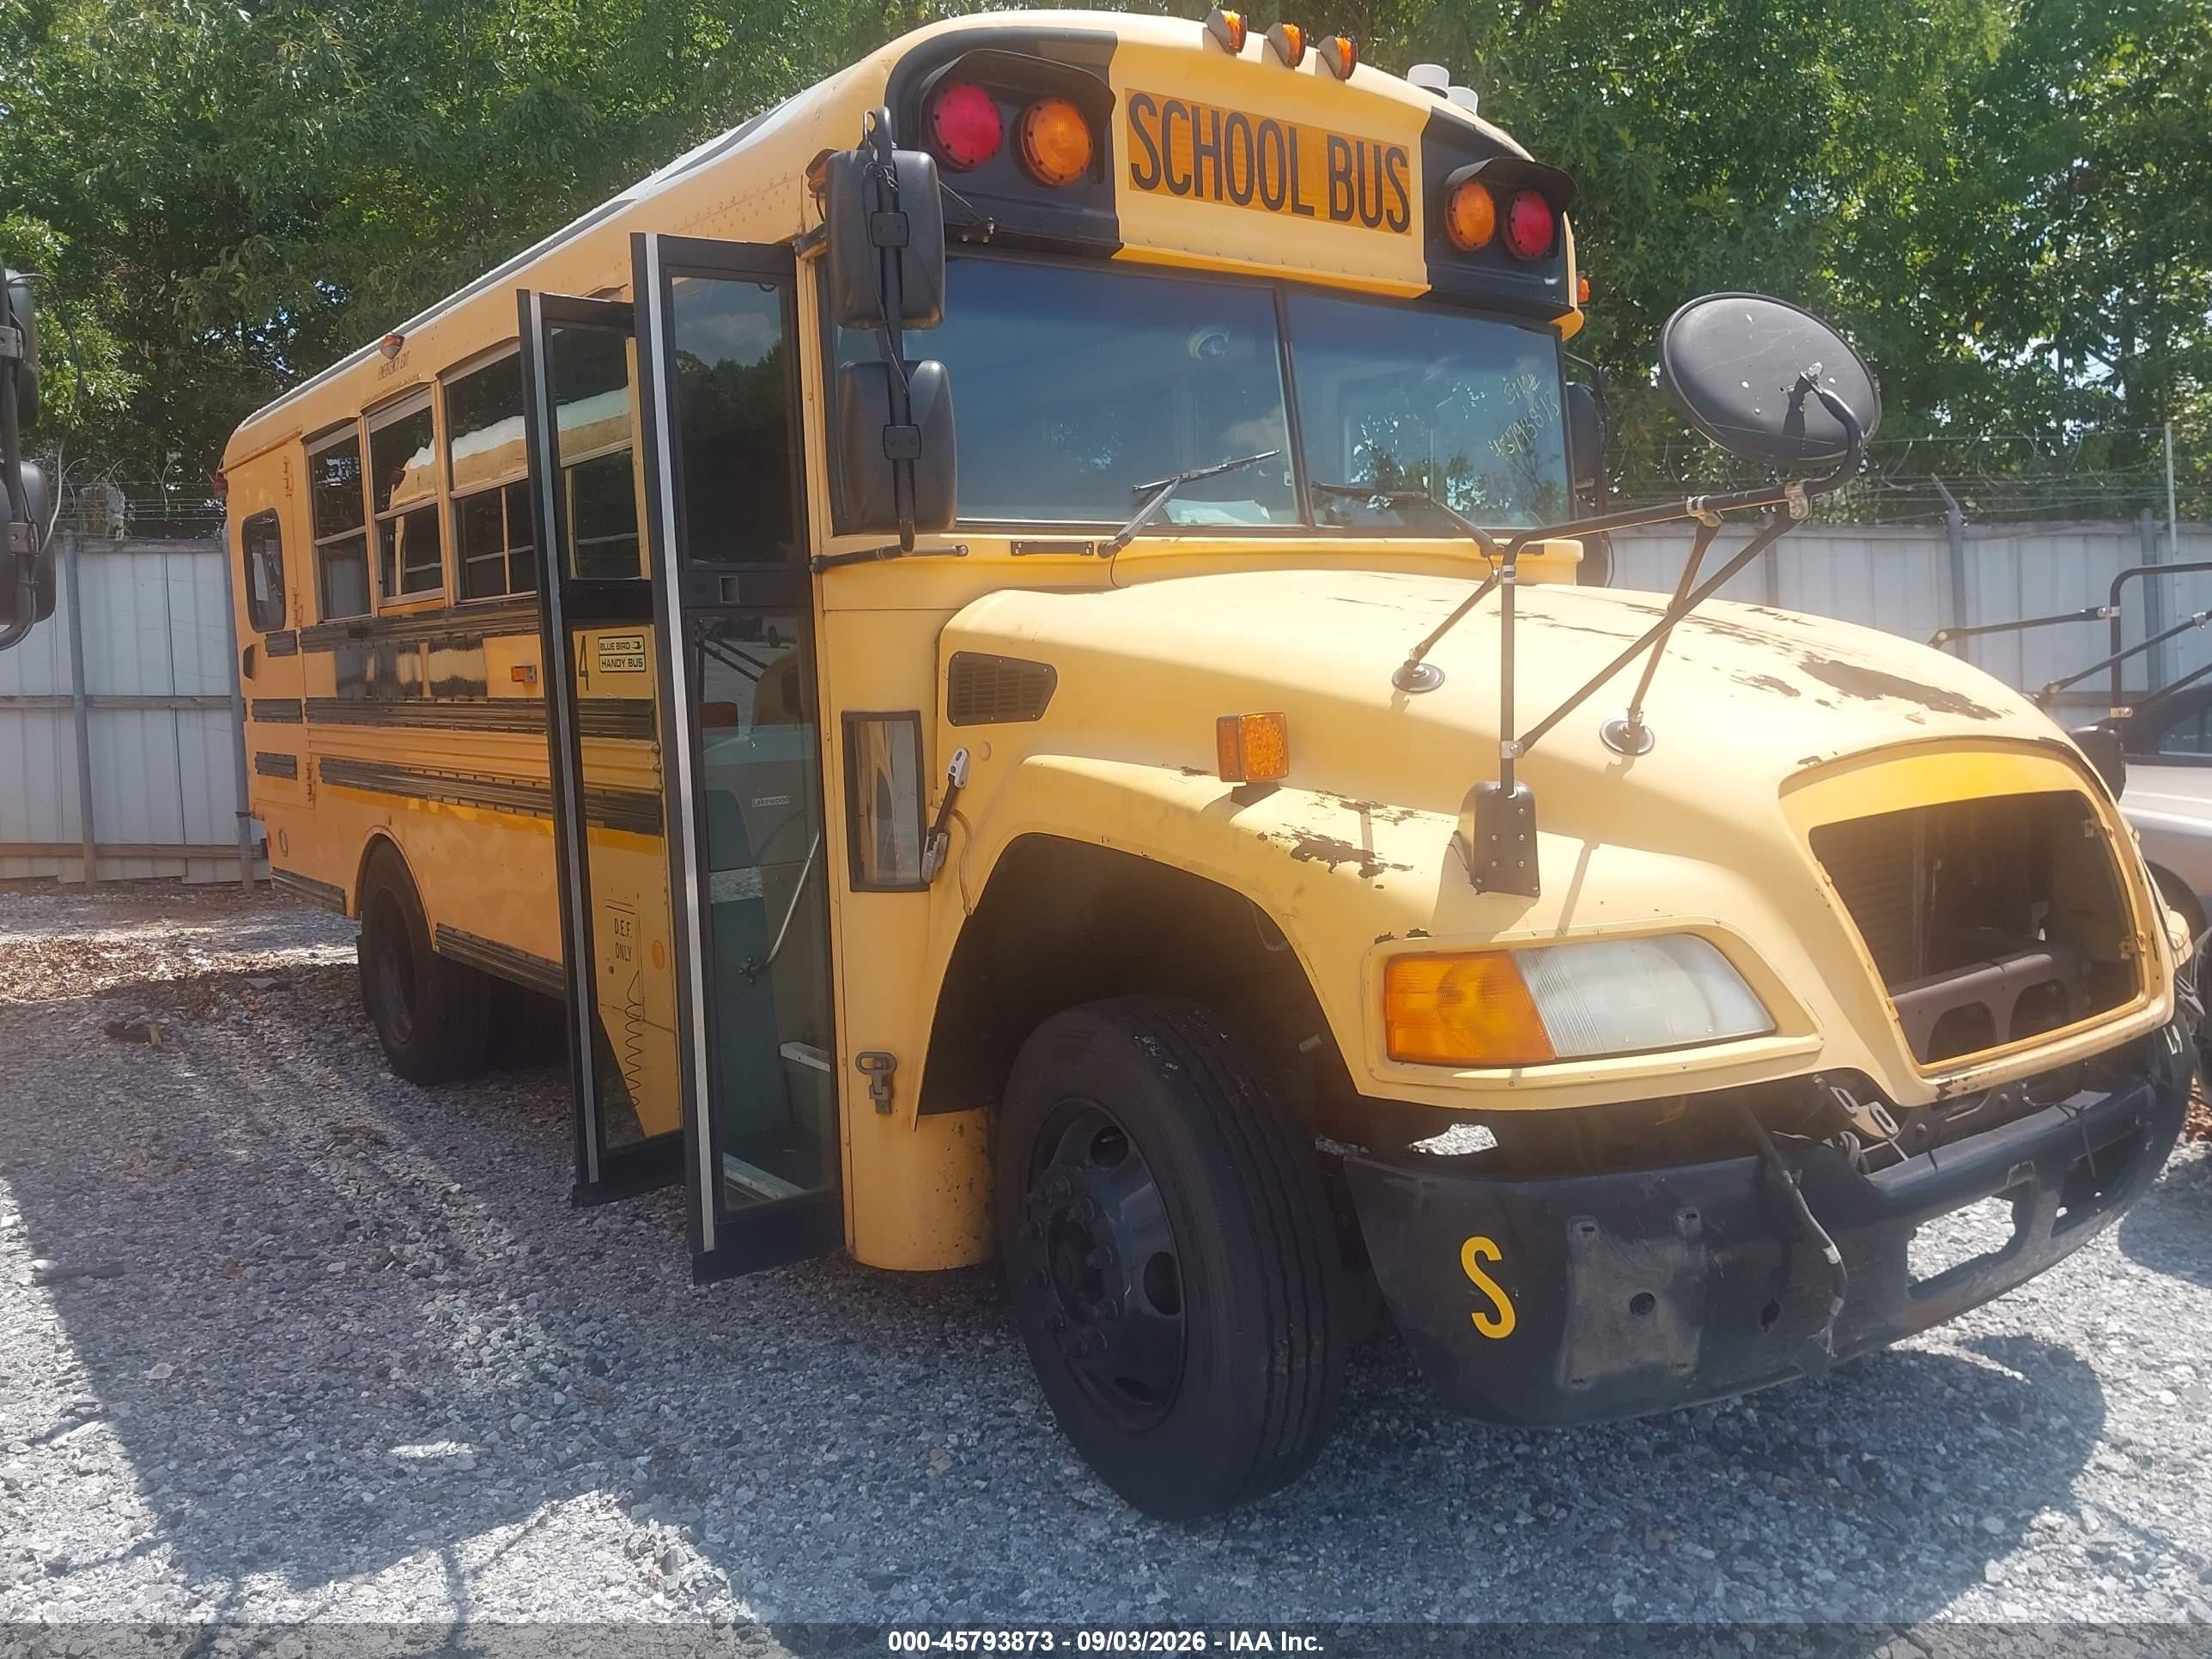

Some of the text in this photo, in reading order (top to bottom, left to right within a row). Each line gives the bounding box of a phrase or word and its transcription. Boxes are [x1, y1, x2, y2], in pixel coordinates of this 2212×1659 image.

[1128, 93, 1410, 233] SCHOOL BUS
[579, 635, 590, 691] 4
[599, 641, 631, 651] BLUE BIRD
[601, 658, 643, 668] HANDY BUS
[615, 942, 632, 962] ONLY
[1461, 1236, 1516, 1339] S
